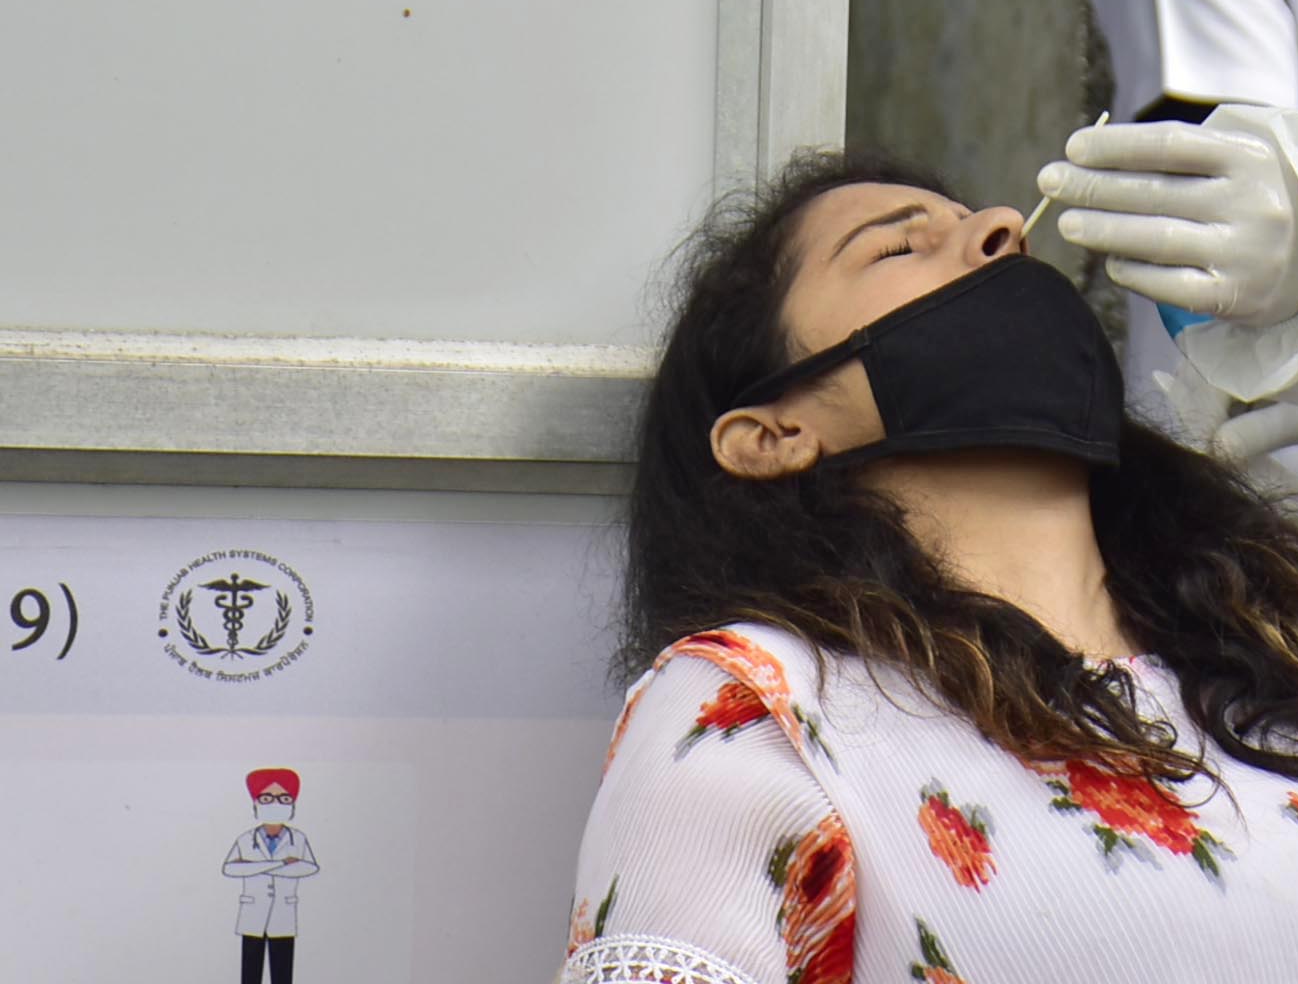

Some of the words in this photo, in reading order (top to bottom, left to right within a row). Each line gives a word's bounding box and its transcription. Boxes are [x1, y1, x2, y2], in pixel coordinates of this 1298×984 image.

[162, 568, 189, 600] PUNJAB
[188, 551, 226, 571] HEALTH
[229, 549, 277, 566] SYSTEMS
[278, 562, 314, 623] CORPORATION
